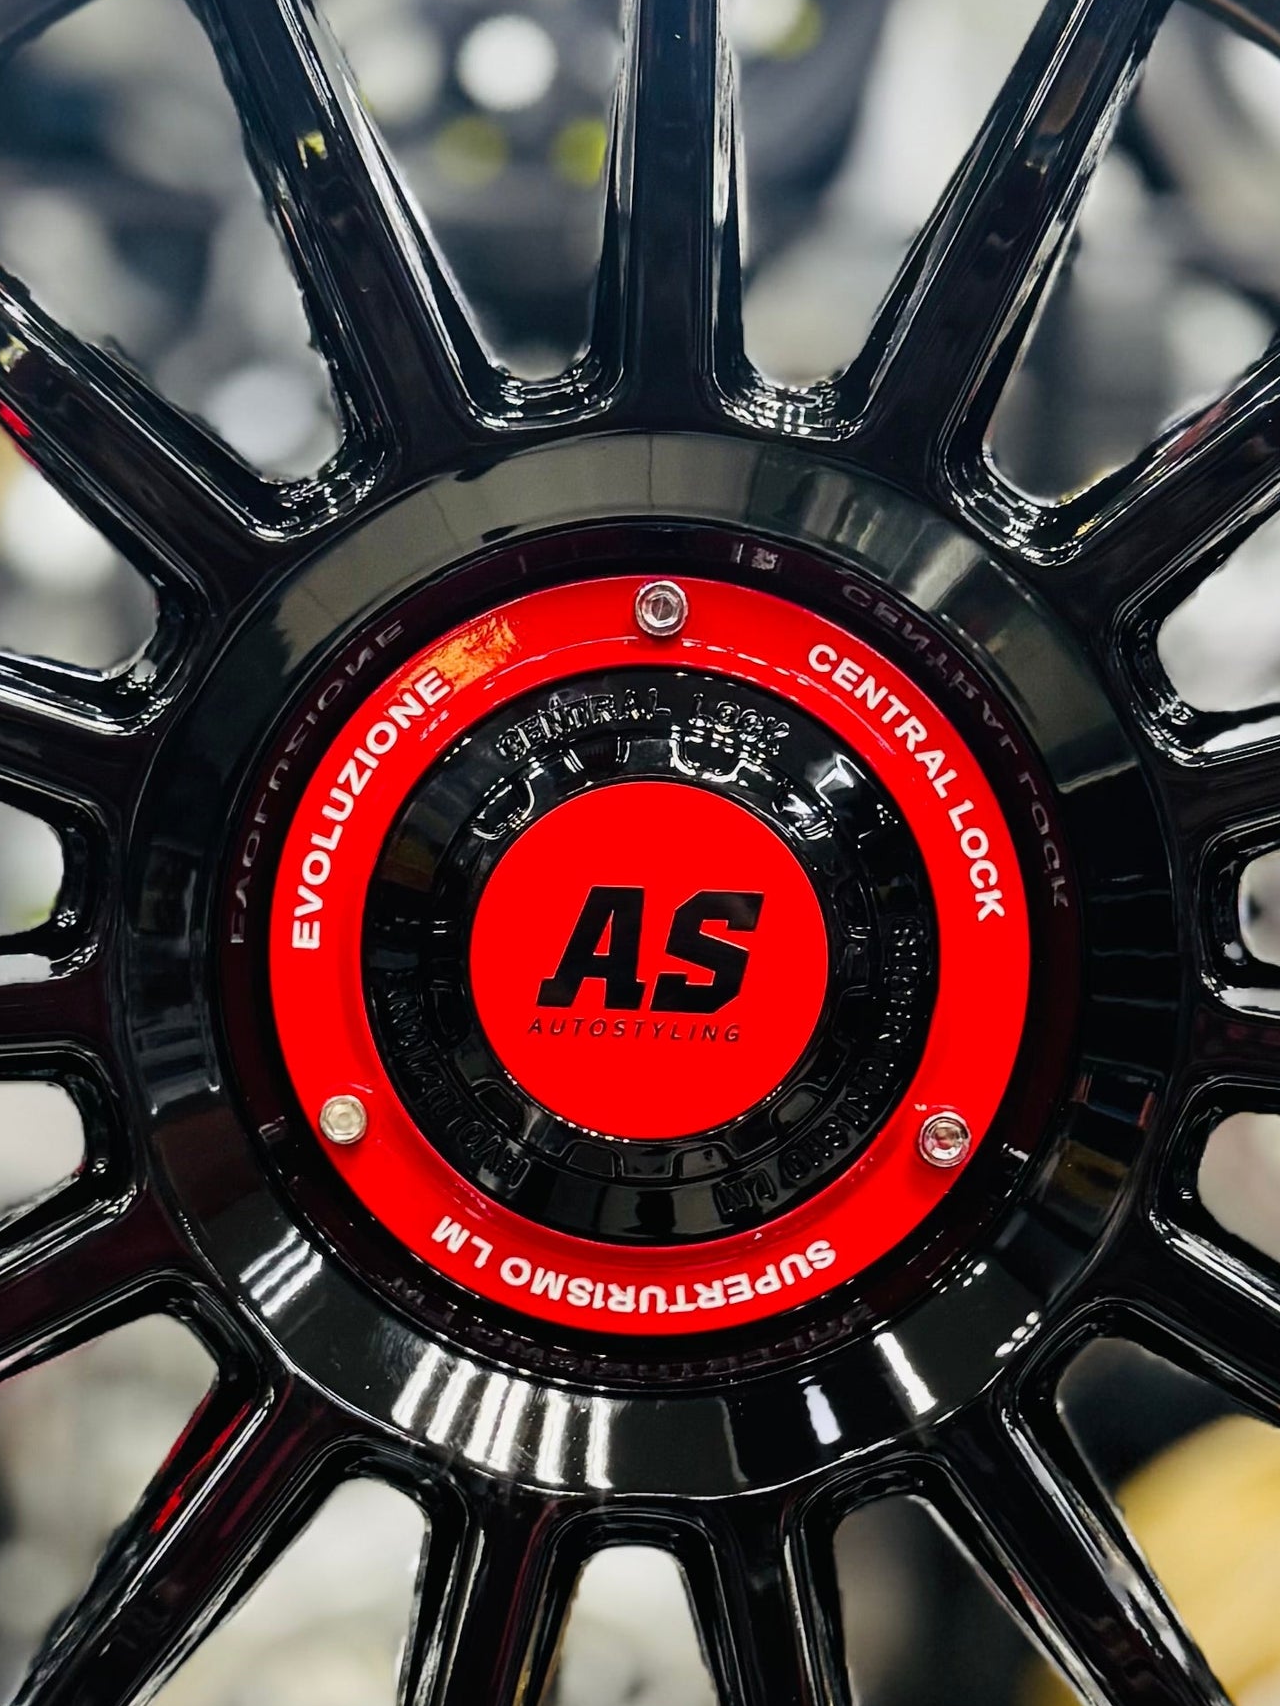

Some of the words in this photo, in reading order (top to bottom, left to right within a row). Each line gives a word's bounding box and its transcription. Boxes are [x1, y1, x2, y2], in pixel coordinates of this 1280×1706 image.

[496, 688, 671, 761] CENTRAL
[292, 667, 452, 949] EVOLUZIONE
[808, 644, 959, 799] CENTRAL
[948, 799, 1005, 921] LOCK
[535, 885, 764, 1014] AS
[527, 1018, 741, 1043] AUTOSTYLING
[431, 1215, 493, 1268] LM
[501, 1239, 837, 1313] SUPERTURISMO
